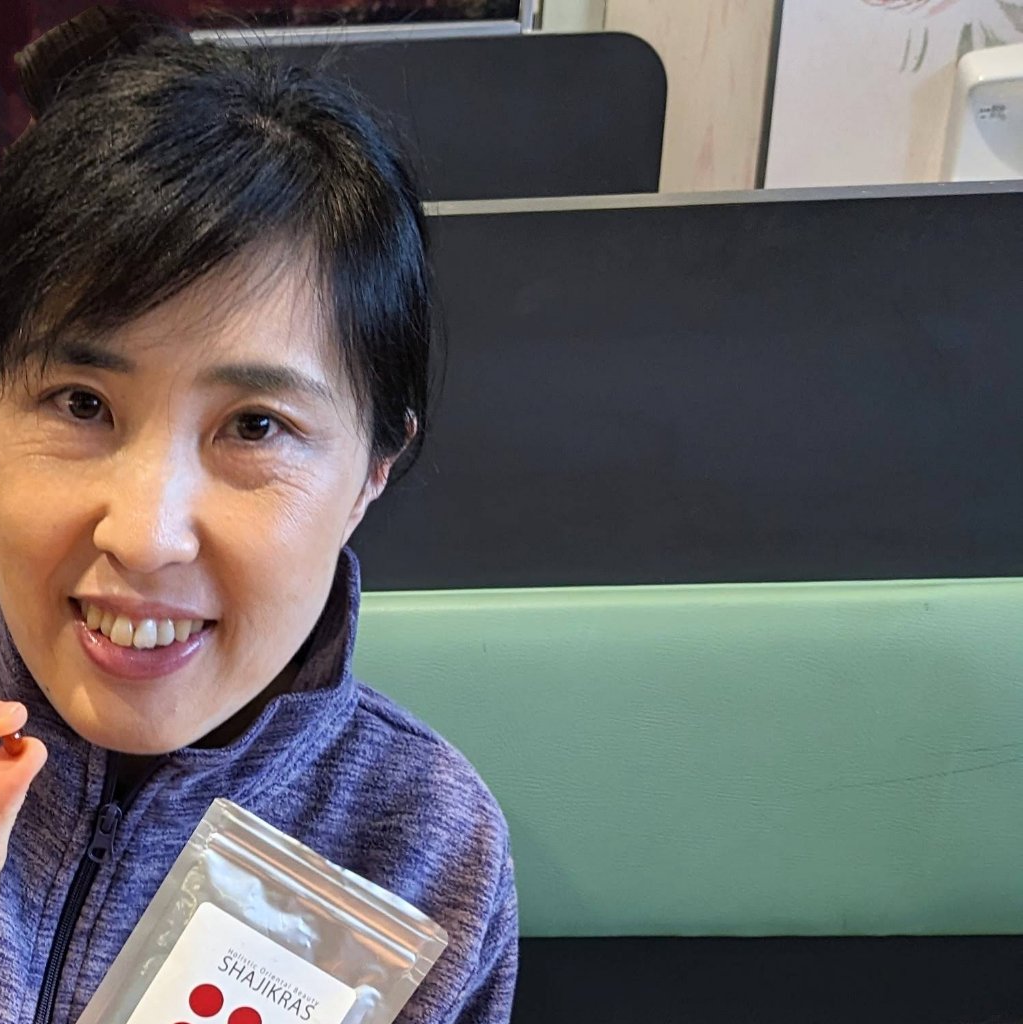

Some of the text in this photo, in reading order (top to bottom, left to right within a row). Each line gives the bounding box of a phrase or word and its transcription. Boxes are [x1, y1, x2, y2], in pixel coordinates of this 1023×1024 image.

[217, 955, 316, 1021] SHAJIKRAS
[227, 948, 320, 1007] Holistic Oriental Beauty
